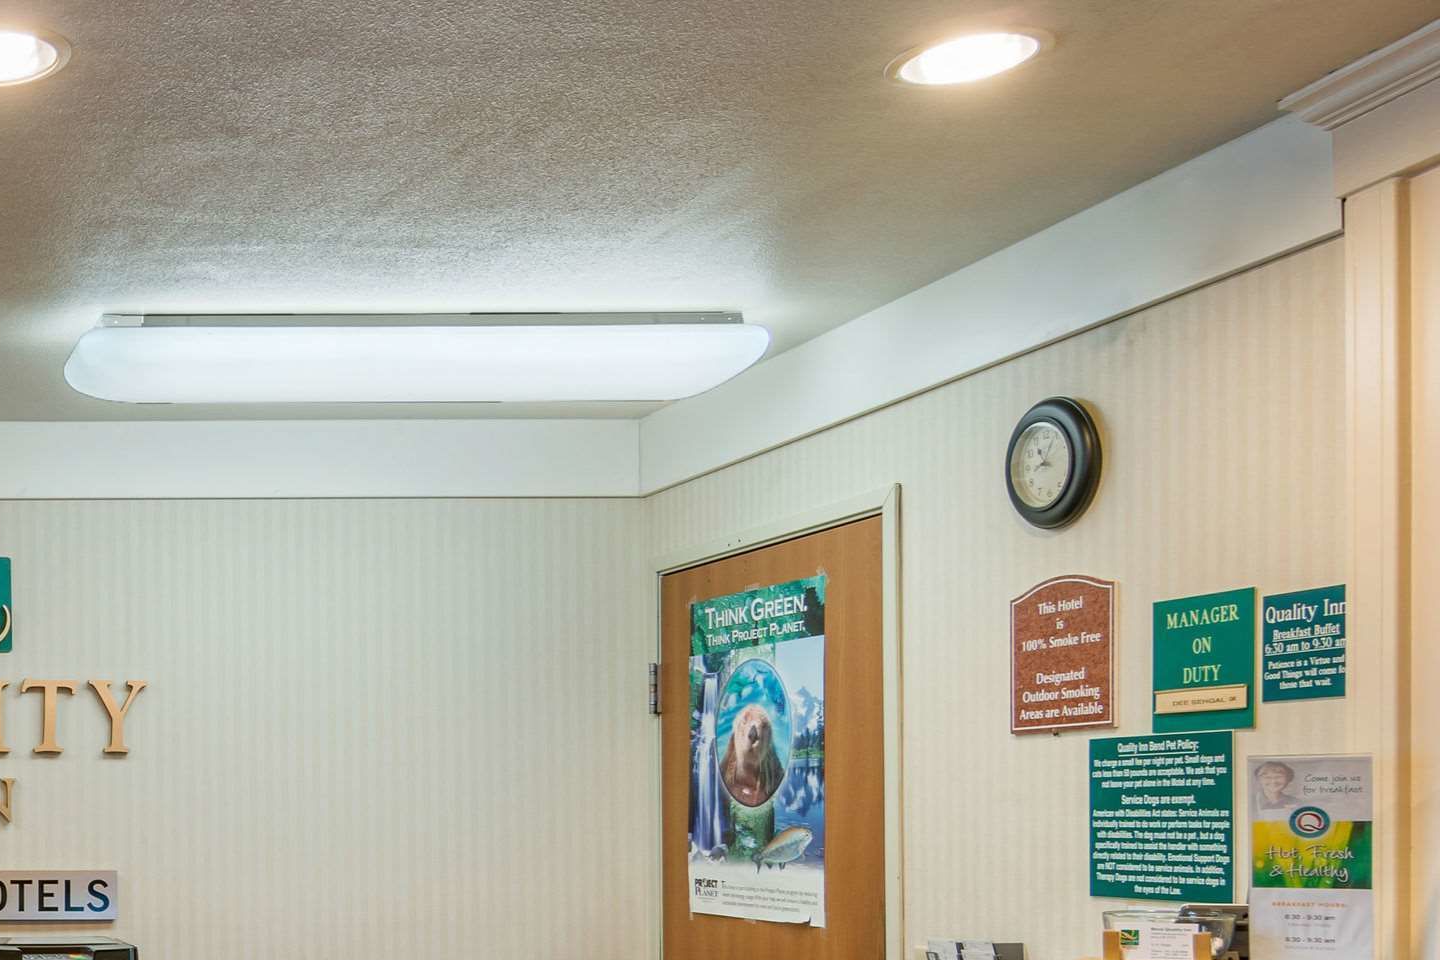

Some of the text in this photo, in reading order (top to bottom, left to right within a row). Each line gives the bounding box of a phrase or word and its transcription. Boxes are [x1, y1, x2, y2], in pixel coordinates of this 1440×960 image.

[704, 594, 807, 629] THINK GREEN.
[1037, 596, 1083, 615] This Hotel
[1266, 599, 1345, 623] Quality Inn
[1056, 618, 1064, 629] is
[1166, 604, 1239, 629] MANAGER
[706, 620, 805, 646] THINK PROJECT PLANET.
[1273, 623, 1340, 640] Breakfast Buffet
[1022, 632, 1101, 652] 100% Smoke Free
[1192, 636, 1211, 654] ON
[1265, 642, 1284, 653] 6:30
[1301, 641, 1310, 650] to
[1312, 637, 1332, 648] 9:30
[1268, 661, 1295, 669] Patience
[1310, 657, 1330, 665] Virtue
[1036, 667, 1084, 685] Designated
[1183, 664, 1221, 684] DUTY
[1264, 671, 1280, 680] Good
[1282, 670, 1303, 679] Things
[1304, 668, 1317, 676] will
[1023, 685, 1100, 703] Outdoor Smoking
[1280, 681, 1297, 689] those
[1020, 702, 1104, 720] Areas are Available
[1118, 743, 1137, 755] Quality
[1139, 742, 1148, 751] Inn
[1149, 741, 1165, 751] Bend
[1166, 741, 1176, 750] Pet
[1121, 795, 1143, 804] Service
[1144, 795, 1159, 805] Dogs
[1161, 796, 1169, 804] are
[1265, 845, 1354, 860] Hot, Fresh
[1269, 863, 1348, 882] & Healthy
